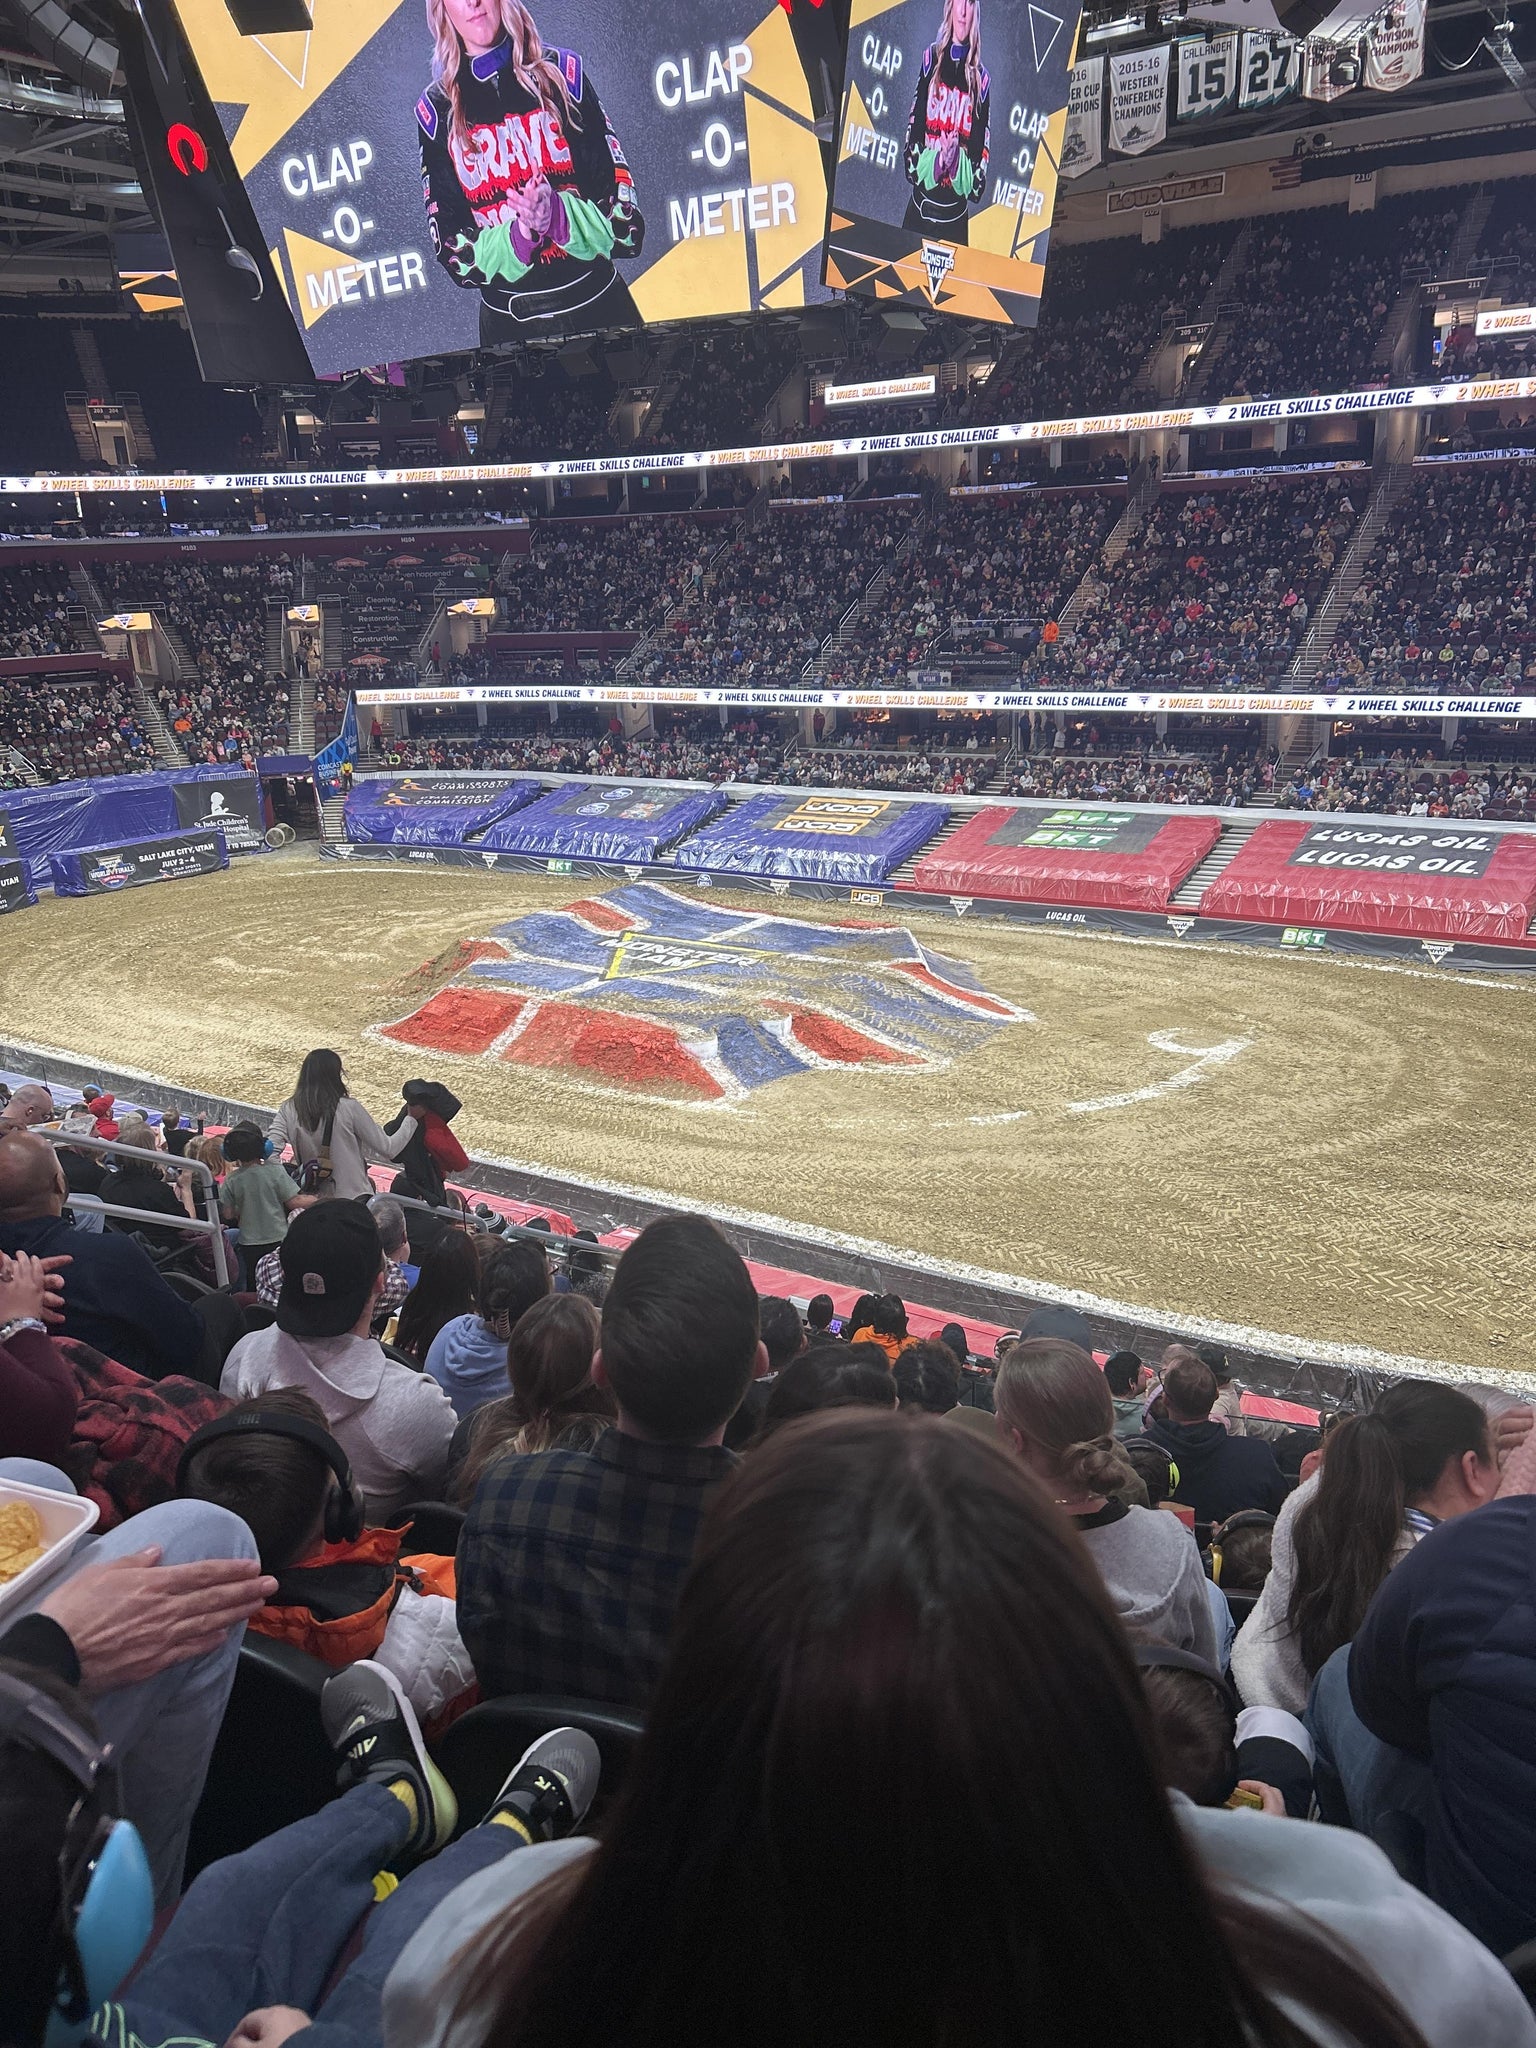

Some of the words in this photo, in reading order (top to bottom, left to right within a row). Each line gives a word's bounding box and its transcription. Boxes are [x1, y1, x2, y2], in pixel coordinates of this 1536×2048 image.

[1376, 27, 1414, 44] DIVISION
[862, 35, 902, 77] CLAP
[1183, 41, 1232, 60] CALLANDER
[1370, 39, 1419, 57] CHAMPIONS
[1119, 57, 1160, 76] 2015-16
[1248, 38, 1292, 93] 27
[655, 44, 753, 107] CLAP
[1119, 74, 1159, 92] WESTERN
[1188, 58, 1226, 105] 15
[1084, 83, 1100, 97] CUP
[1112, 87, 1165, 107] CONFERENCE
[1114, 103, 1162, 121] CHAMPIONS
[1009, 105, 1049, 140] CLAP
[451, 110, 571, 192] GRAVE
[691, 123, 747, 168] -O-
[846, 123, 899, 169] METER
[282, 140, 373, 197] CLAP
[1355, 173, 1372, 182] 210
[992, 180, 1044, 216] METER
[1110, 176, 1222, 212] LOUDVILLE
[669, 182, 797, 241] METER
[322, 206, 374, 244] -O-
[920, 250, 956, 270] MONSTER
[306, 251, 427, 309] METER
[1483, 319, 1491, 329] 2
[1494, 314, 1532, 328] WHEEL
[829, 392, 835, 400] 2
[836, 388, 860, 399] WHEEL
[862, 385, 887, 397] SKILLS
[889, 381, 931, 393] CHALLENGE
[1456, 387, 1468, 400] 2
[1471, 382, 1521, 399] WHEEL
[1228, 407, 1236, 419] 2
[1241, 402, 1283, 418] WHEEL
[1286, 397, 1332, 414] SKILLS
[1335, 390, 1415, 411] CHALLENGE
[1031, 426, 1038, 437] 2
[1041, 422, 1078, 436] WHEEL
[1081, 417, 1121, 433] SKILLS
[1124, 411, 1194, 429] CHALLENGE
[861, 440, 867, 450] 2
[869, 437, 901, 450] WHEEL
[904, 433, 938, 448] SKILLS
[940, 428, 999, 444] CHALLENGE
[709, 453, 716, 464] 2
[717, 451, 746, 463] WHEEL
[749, 447, 779, 461] SKILLS
[781, 443, 834, 459] CHALLENGE
[558, 463, 565, 473] 2
[566, 461, 597, 472] WHEEL
[599, 459, 630, 471] SKILLS
[633, 455, 685, 468] CHALLENGE
[225, 477, 233, 487] 2
[235, 475, 270, 487] WHEEL
[272, 474, 308, 486] SKILLS
[309, 472, 367, 485] CHALLENGE
[396, 472, 402, 483] 2
[405, 470, 438, 482] WHEEL
[440, 468, 473, 480] SKILLS
[476, 466, 532, 478] CHALLENGE
[41, 480, 48, 490] 2
[51, 480, 90, 490] WHEEL
[92, 479, 131, 490] SKILLS
[133, 478, 196, 490] CHALLENGE
[358, 614, 400, 623] Restoration.
[353, 635, 399, 643] Construction.
[384, 692, 412, 701] SKILLS
[414, 691, 460, 700] CHALLENGE
[481, 690, 487, 698] 2
[488, 690, 512, 698] WHEEL
[515, 689, 540, 698] SKILLS
[542, 689, 581, 698] CHALLENGE
[600, 691, 605, 699] 2
[606, 690, 629, 700] WHEEL
[632, 691, 655, 700] SKILLS
[657, 691, 698, 701] CHALLENGE
[718, 692, 723, 701] 2
[725, 692, 749, 702] WHEEL
[751, 692, 776, 702] SKILLS
[779, 692, 823, 703] CHALLENGE
[847, 695, 852, 704] 2
[855, 695, 883, 705] WHEEL
[885, 695, 914, 705] SKILLS
[917, 695, 968, 706] CHALLENGE
[994, 696, 1000, 705] 2
[1002, 696, 1033, 706] WHEEL
[1036, 696, 1068, 706] SKILLS
[1071, 696, 1128, 707] CHALLENGE
[1158, 698, 1165, 708] 2
[1168, 698, 1204, 709] WHEEL
[1207, 698, 1245, 709] SKILLS
[1248, 698, 1314, 711] CHALLENGE
[1347, 700, 1355, 711] 2
[1358, 700, 1399, 712] WHEEL
[1402, 700, 1444, 712] SKILLS
[1447, 701, 1522, 713] CHALLENGE
[319, 769, 340, 778] BUSINE
[203, 820, 217, 829] Jude
[223, 825, 249, 834] Hospital
[1032, 832, 1113, 844] BKT
[1310, 829, 1428, 847] LUCAS
[139, 854, 156, 863] SALT
[157, 850, 176, 860] LAKE
[176, 847, 195, 857] CITY,
[195, 843, 214, 853] UTAH
[162, 859, 178, 868] JULY
[190, 856, 196, 864] 4
[1296, 850, 1415, 869] LUCAS
[90, 870, 111, 879] WORLD
[548, 861, 571, 871] BKT
[1, 876, 19, 887] UTAH
[853, 892, 880, 903] JCB
[1046, 911, 1073, 922] LUCAS
[1073, 914, 1086, 923] OIL
[1283, 930, 1325, 945] BKT
[598, 938, 762, 968] MONSTER
[1422, 943, 1454, 952] MONSTER
